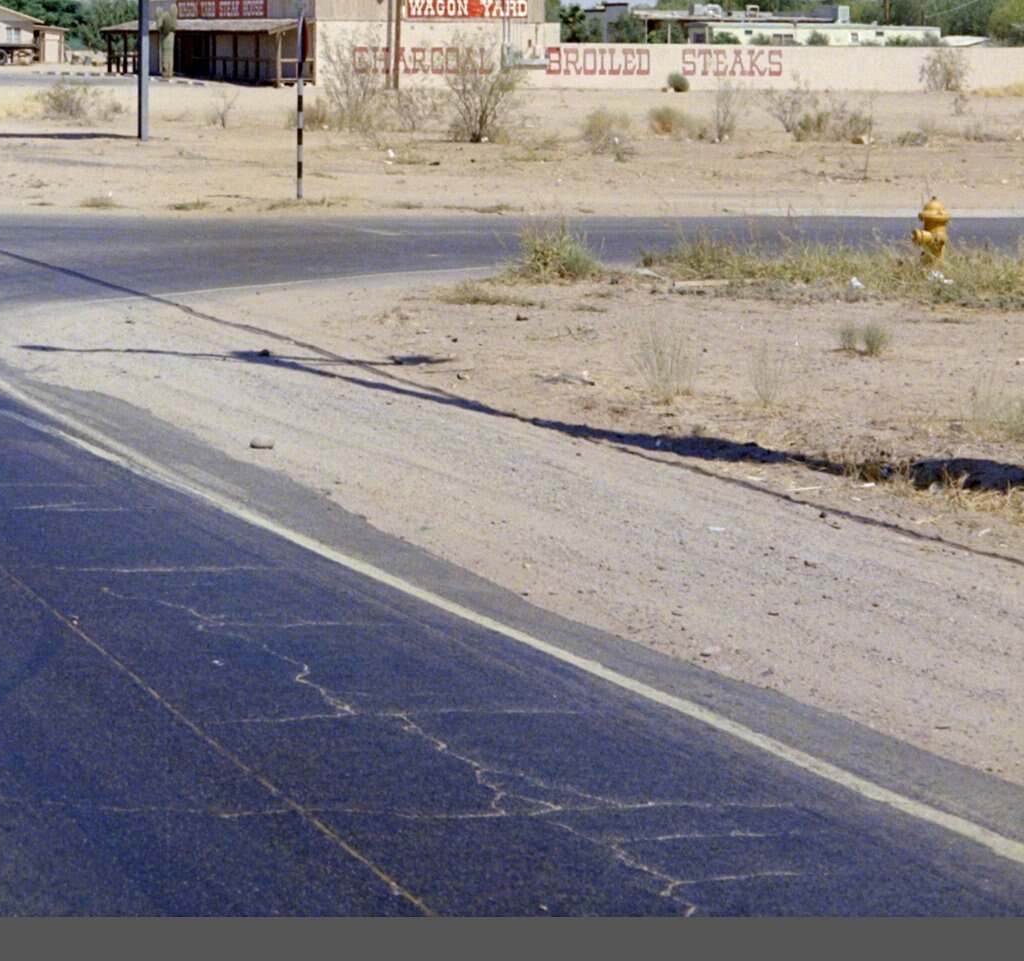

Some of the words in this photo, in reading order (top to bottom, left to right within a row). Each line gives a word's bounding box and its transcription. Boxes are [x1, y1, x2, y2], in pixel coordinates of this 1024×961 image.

[408, 0, 469, 17] WAGON
[481, 0, 528, 17] YARD
[352, 46, 493, 75] CHARCOAL
[546, 47, 650, 75] BROILED
[681, 49, 783, 76] STEAKS
